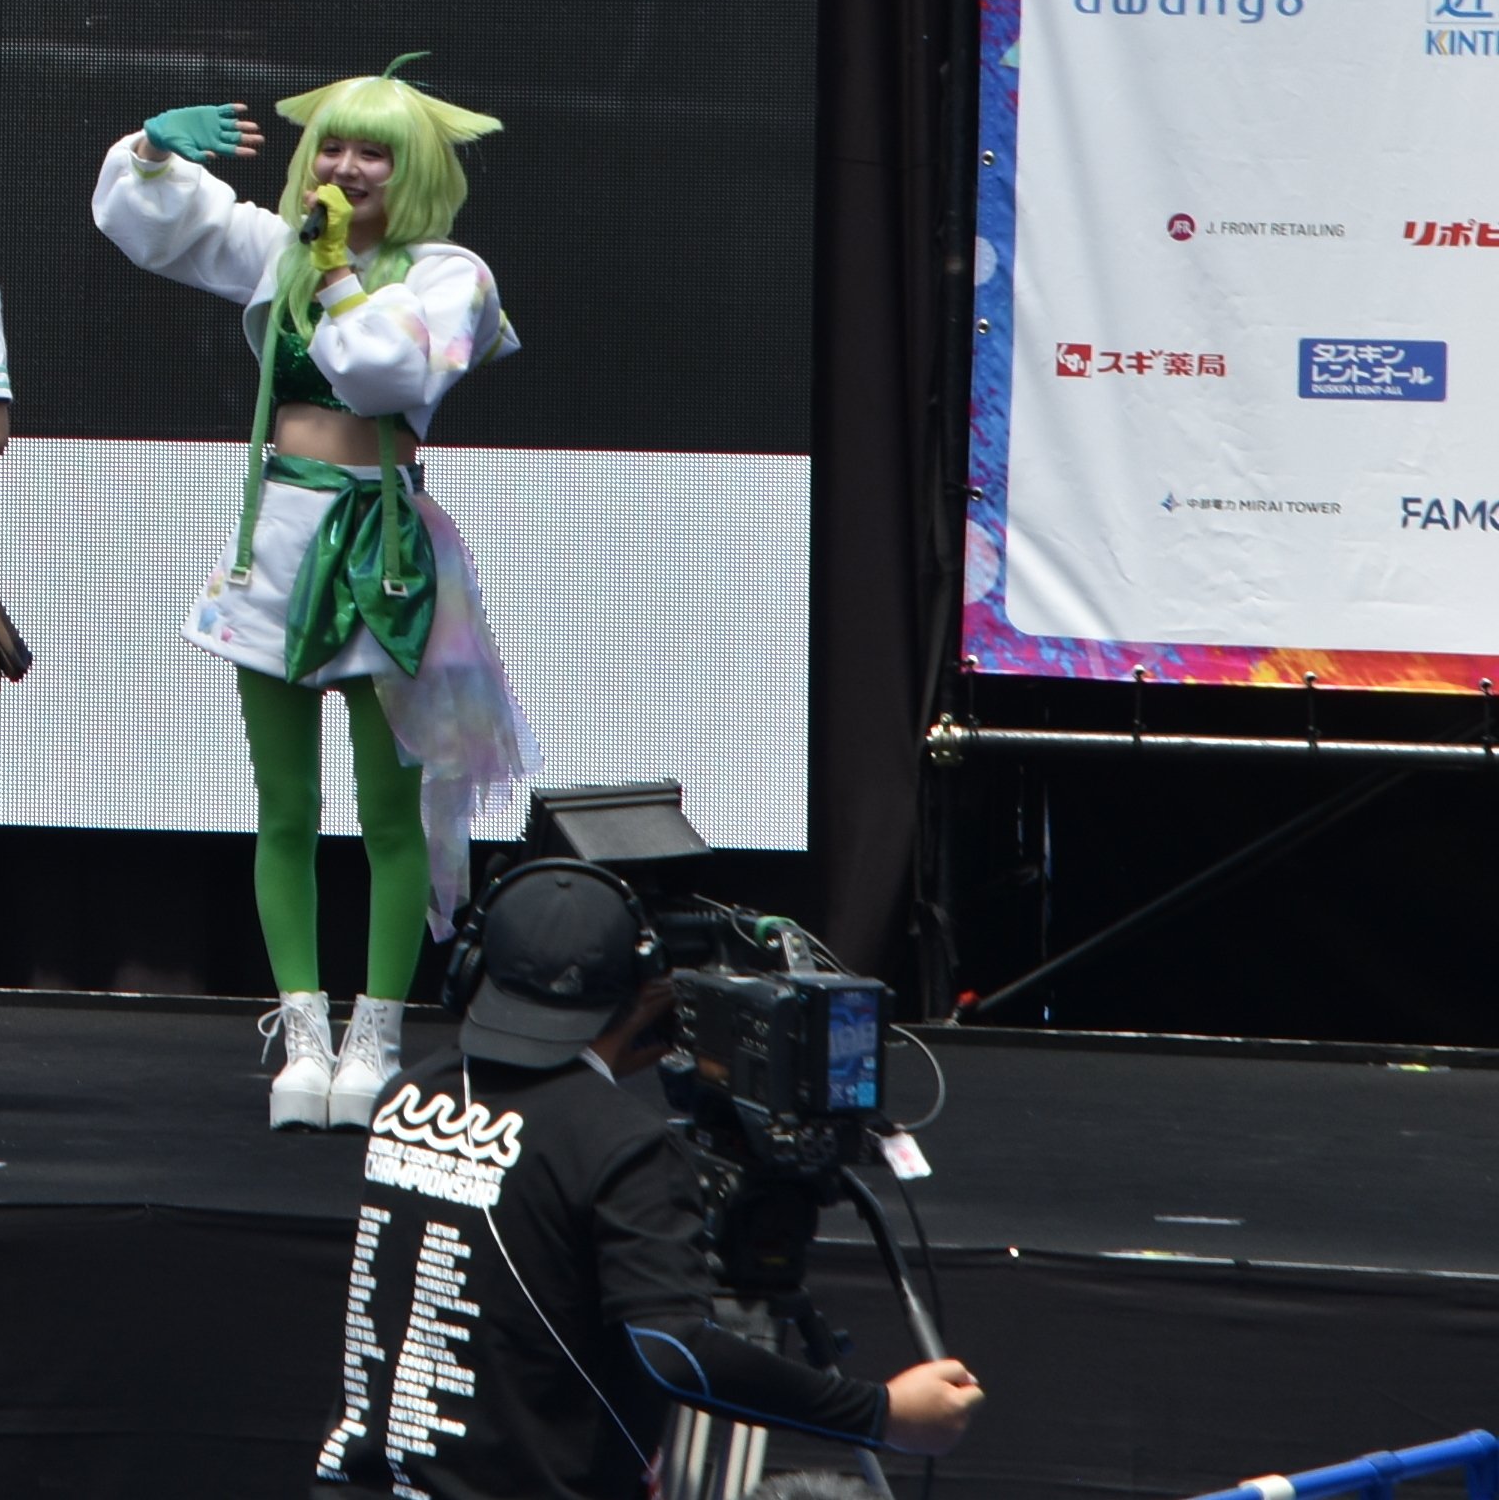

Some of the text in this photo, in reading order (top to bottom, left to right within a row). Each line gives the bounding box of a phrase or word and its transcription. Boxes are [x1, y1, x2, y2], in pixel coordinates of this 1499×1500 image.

[1205, 221, 1345, 237] J. FRONT RETAILING
[1097, 348, 1227, 378] スギ薬局
[1238, 500, 1284, 513] MIRAI
[1286, 501, 1342, 514] TOWER
